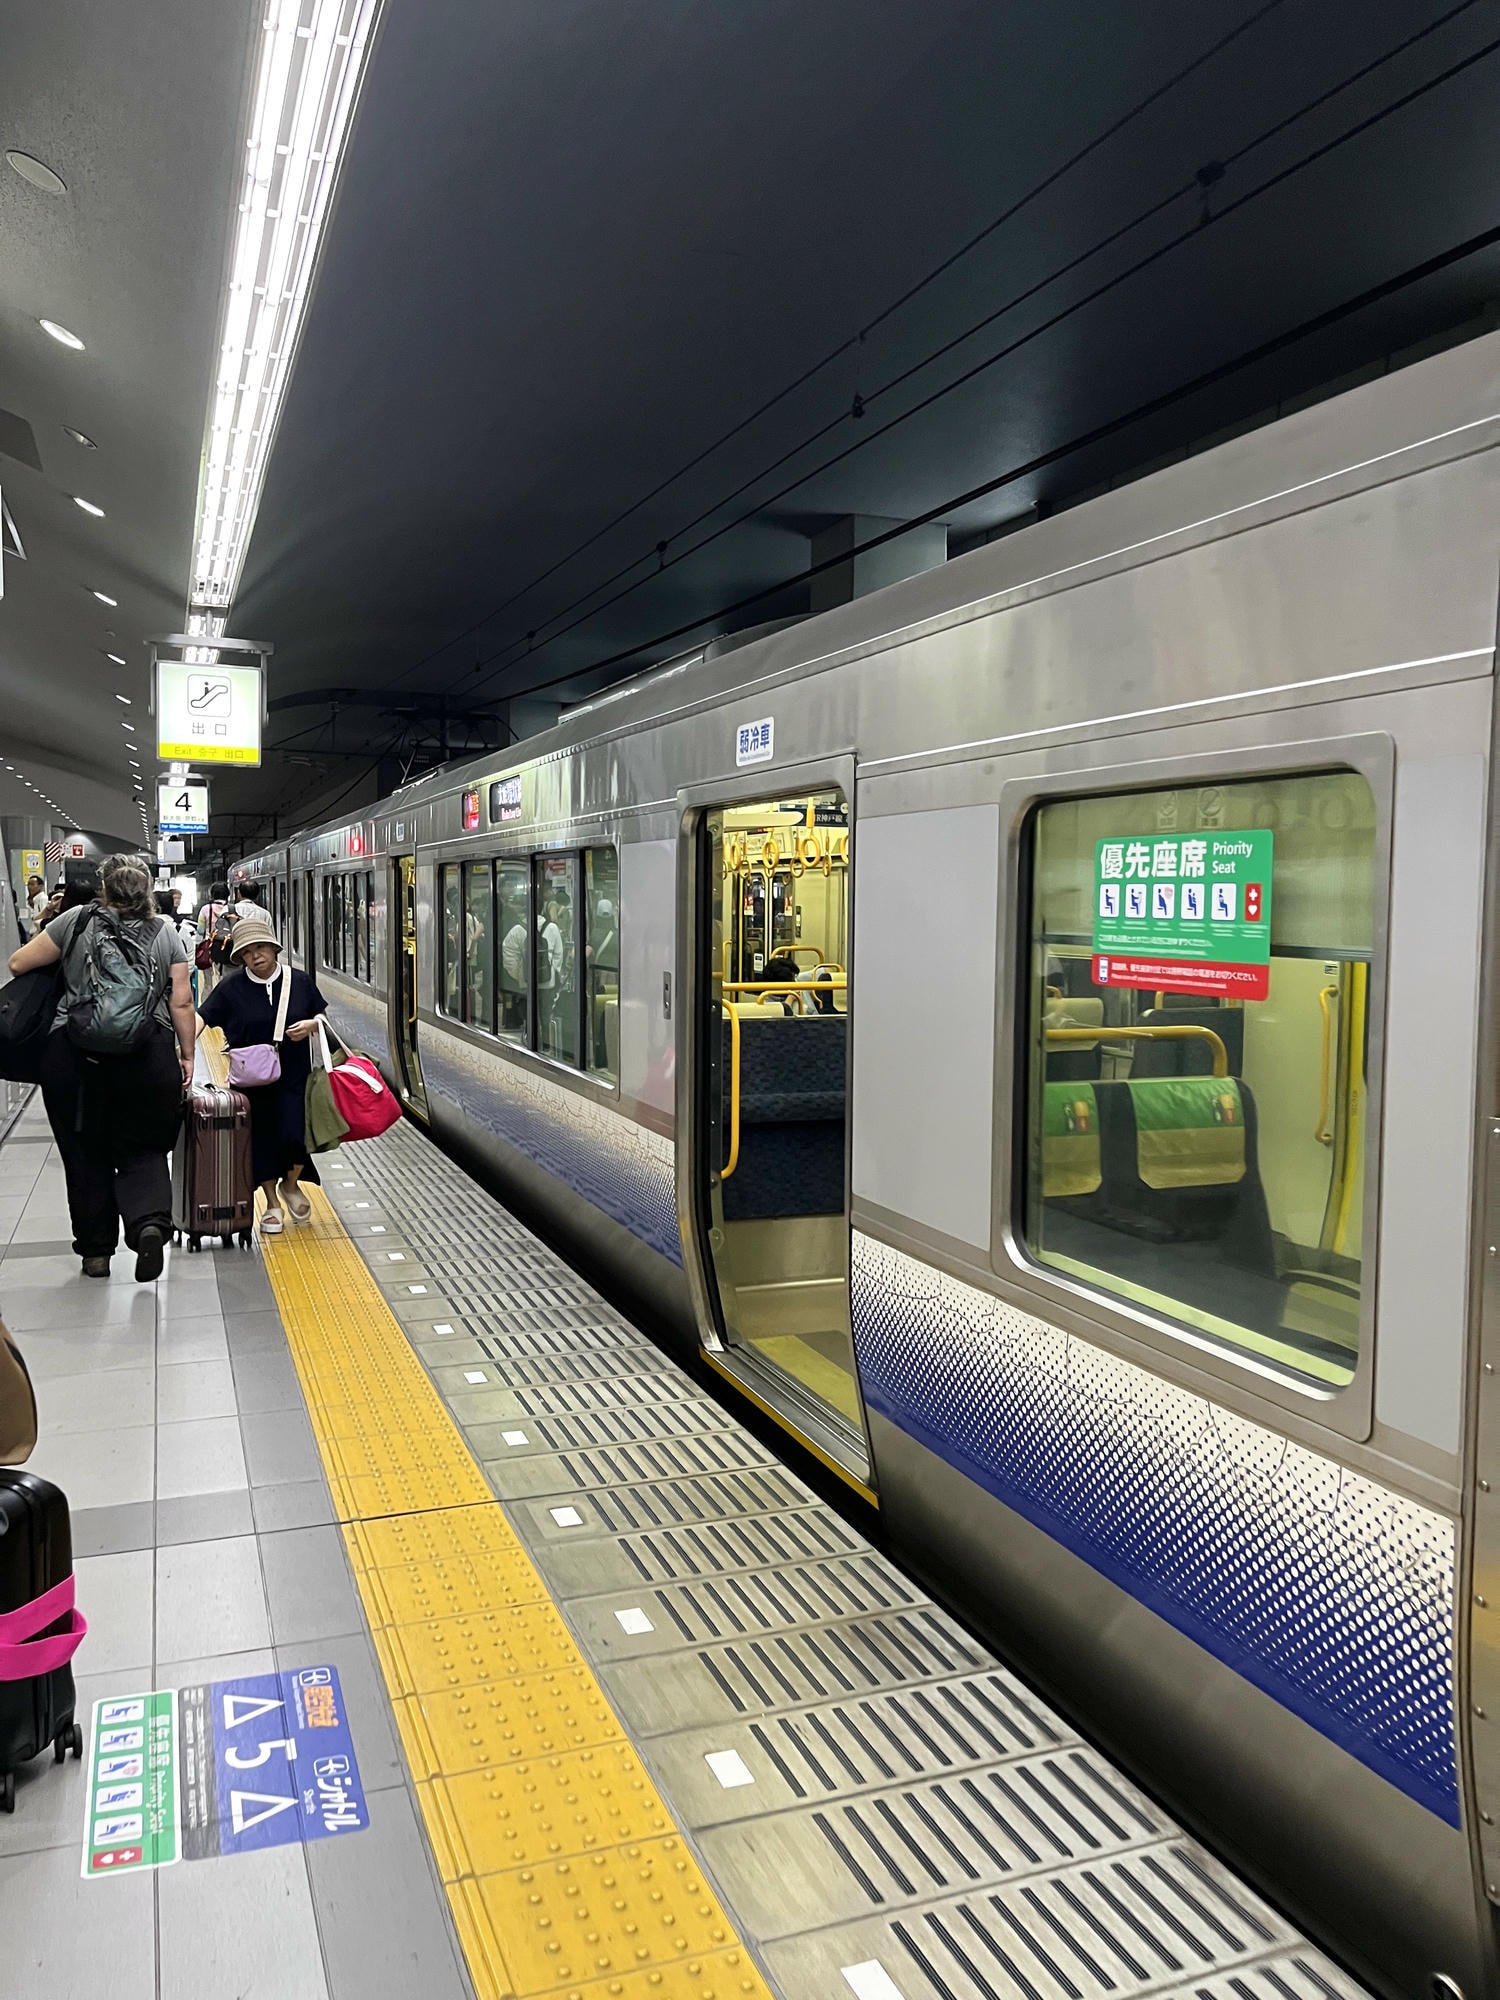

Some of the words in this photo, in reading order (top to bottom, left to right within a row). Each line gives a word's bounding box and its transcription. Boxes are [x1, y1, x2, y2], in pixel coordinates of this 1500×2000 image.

[192, 722, 227, 736] 出口
[739, 723, 770, 754] 弱冷車
[174, 746, 192, 755] Exit
[175, 792, 192, 811] 4
[1212, 840, 1253, 858] Priority
[1100, 839, 1207, 879] 優先座席
[1212, 860, 1236, 875] Seat
[225, 1738, 298, 1770] 5
[317, 1776, 361, 1832] シャトル
